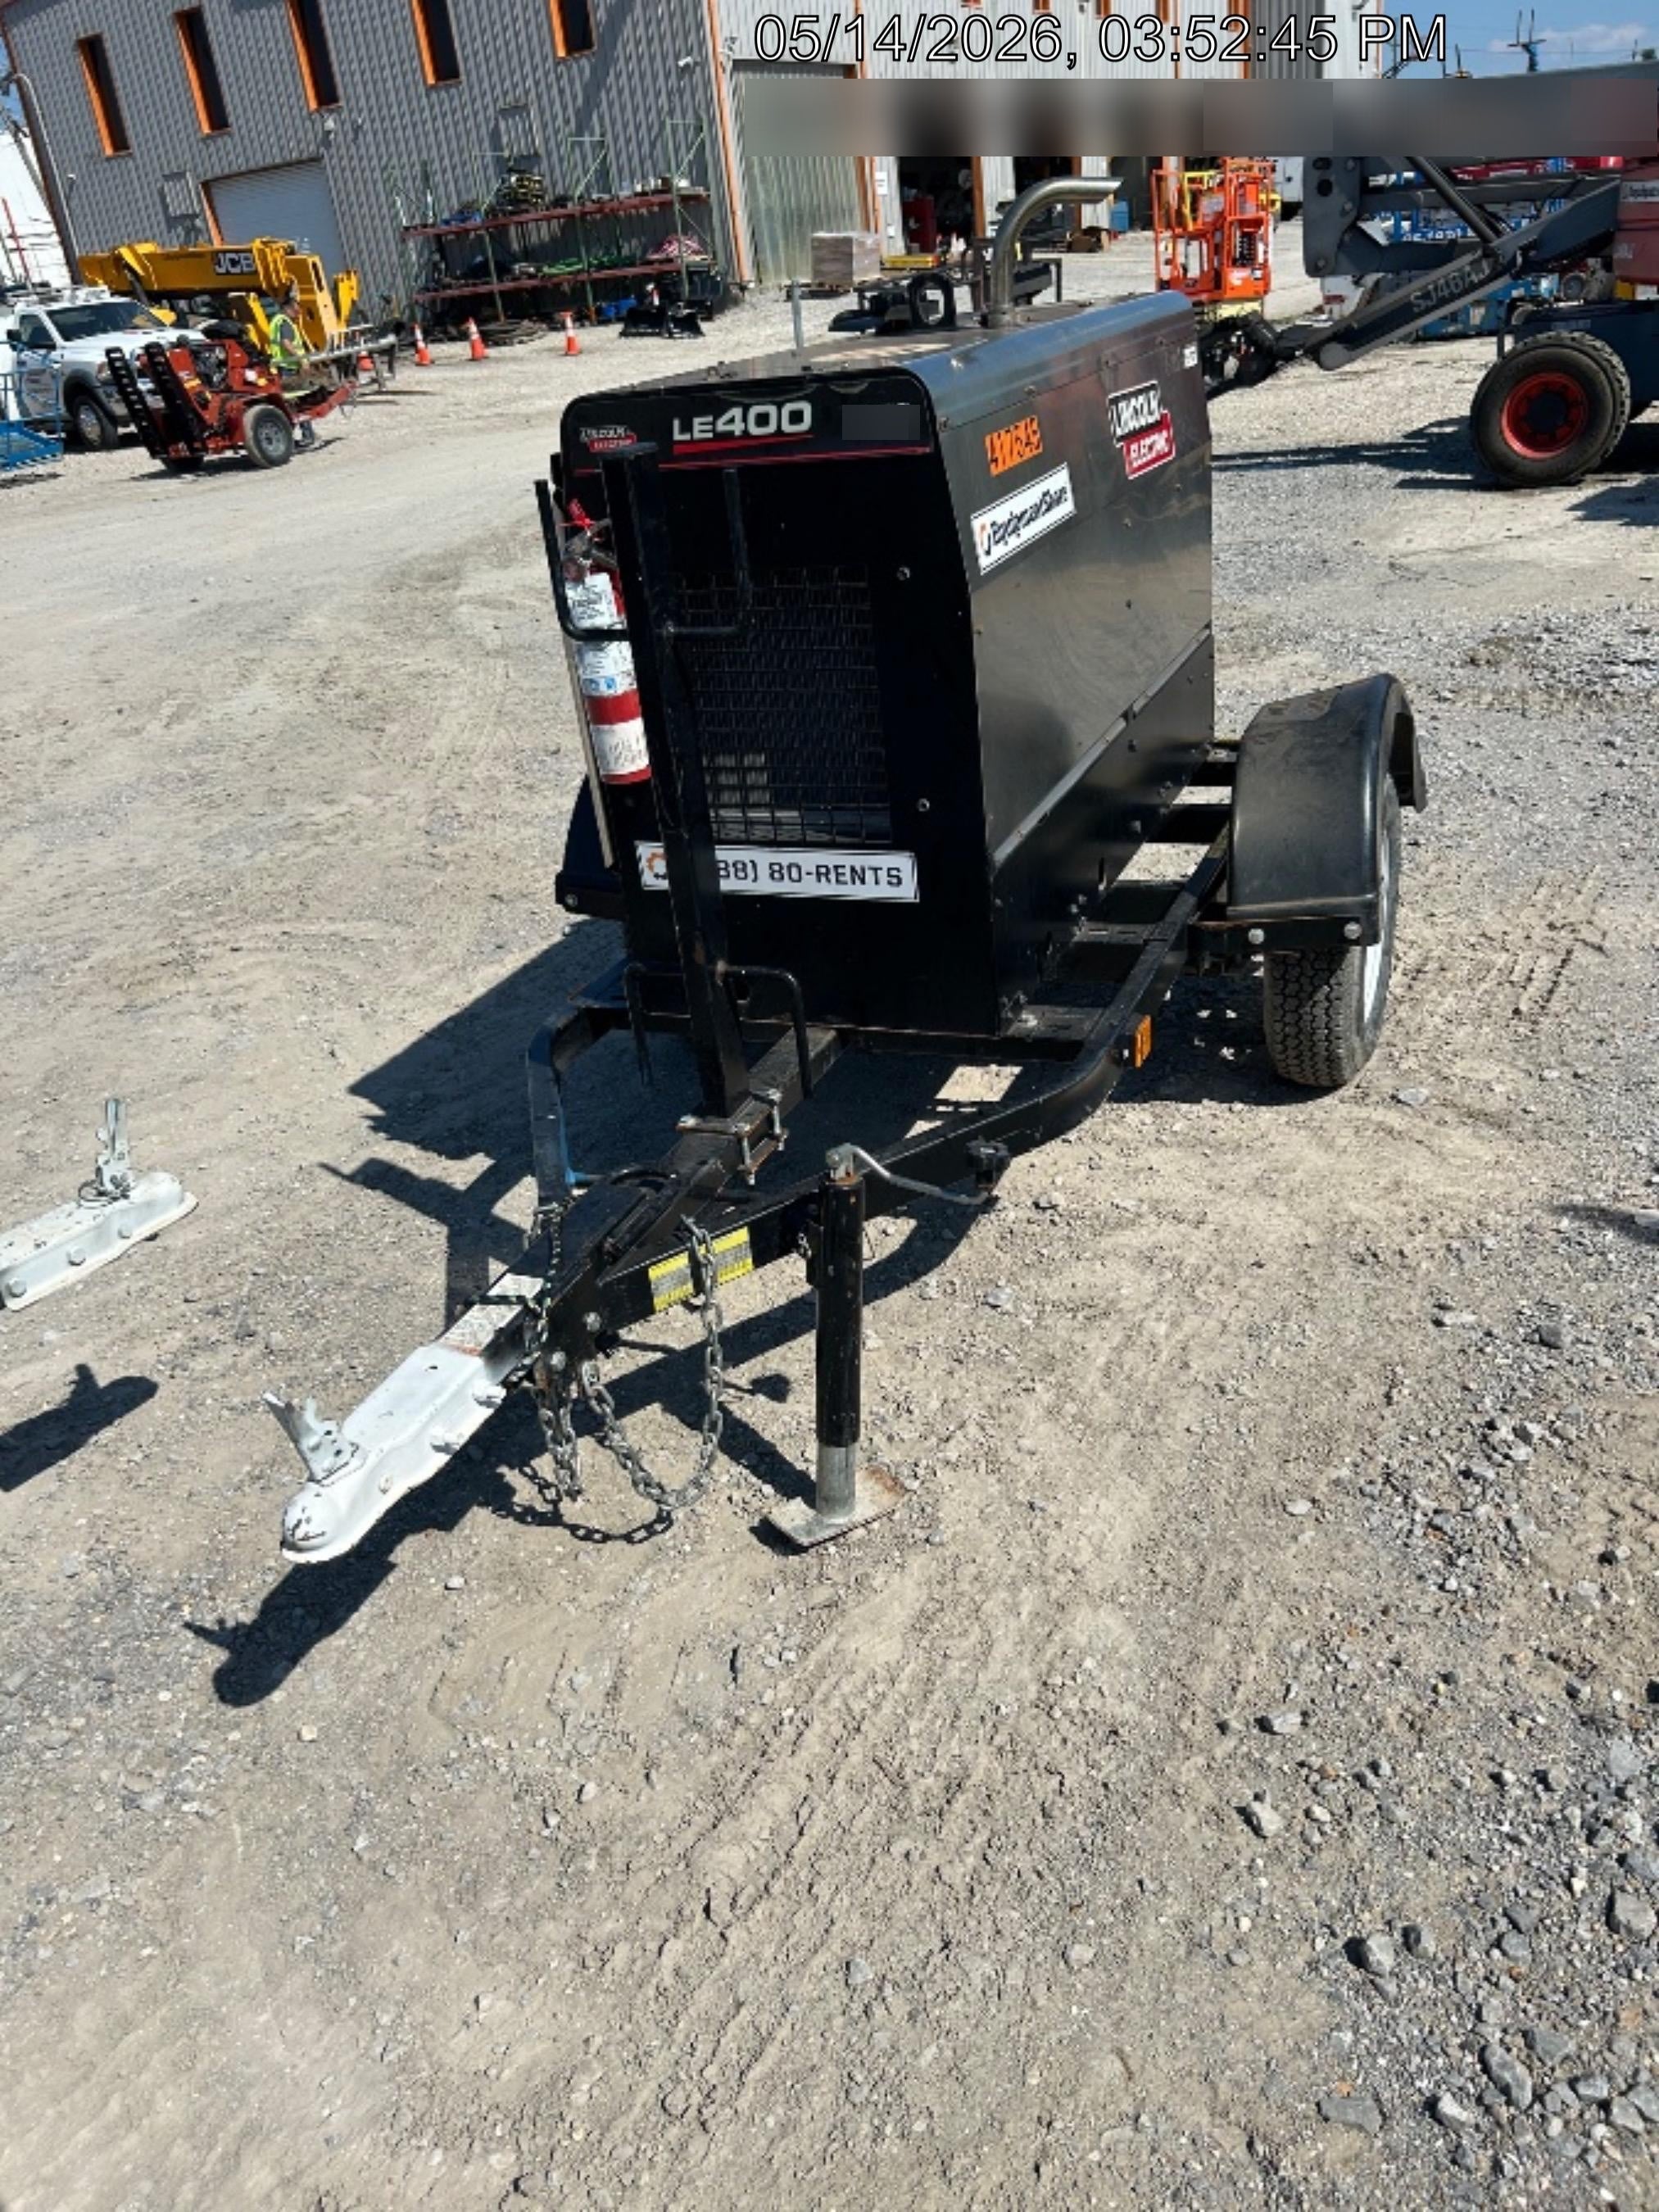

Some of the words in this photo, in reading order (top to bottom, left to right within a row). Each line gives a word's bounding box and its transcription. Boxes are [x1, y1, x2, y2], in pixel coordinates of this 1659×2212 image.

[215, 252, 256, 274] JCB
[673, 401, 813, 442] LE400
[768, 862, 903, 887] 80-RENTS
